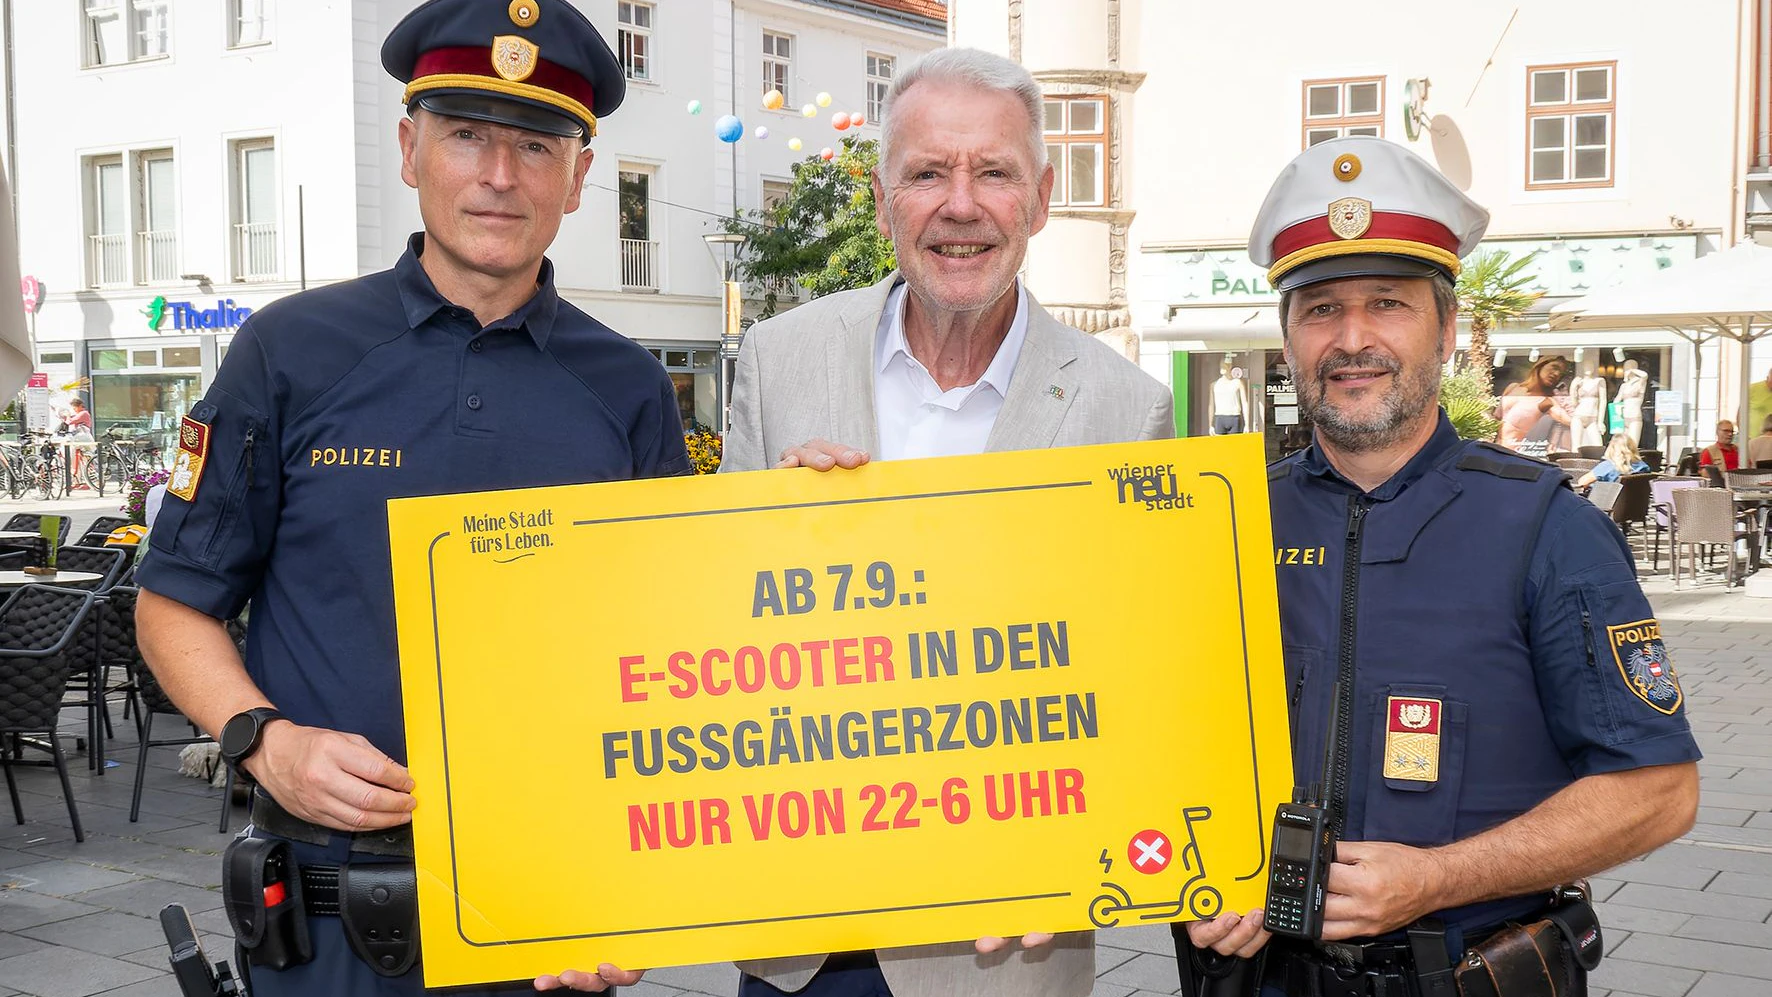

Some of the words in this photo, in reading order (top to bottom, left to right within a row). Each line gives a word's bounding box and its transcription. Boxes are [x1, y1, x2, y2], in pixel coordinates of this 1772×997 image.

[1212, 278, 1276, 295] PAL
[1266, 384, 1297, 393] PALME
[310, 448, 401, 467] POLIZEI
[1107, 463, 1174, 480] wiener
[1116, 473, 1178, 503] neu
[1145, 492, 1194, 511] stadt
[463, 513, 507, 534] Meine
[509, 508, 555, 530] Stadt
[469, 536, 503, 554] fürs
[505, 531, 554, 551] Leben.
[751, 568, 817, 618] AB
[826, 560, 927, 612] 7.9.:
[618, 635, 896, 704] E-SCOOTER
[907, 629, 959, 680] IN
[972, 620, 1071, 675] DEN
[601, 691, 1100, 780] FUSSGÄNGERZONEN
[627, 798, 733, 852] NUR
[741, 787, 847, 841] VON
[859, 777, 971, 833] 22-6
[983, 767, 1088, 821] UHR
